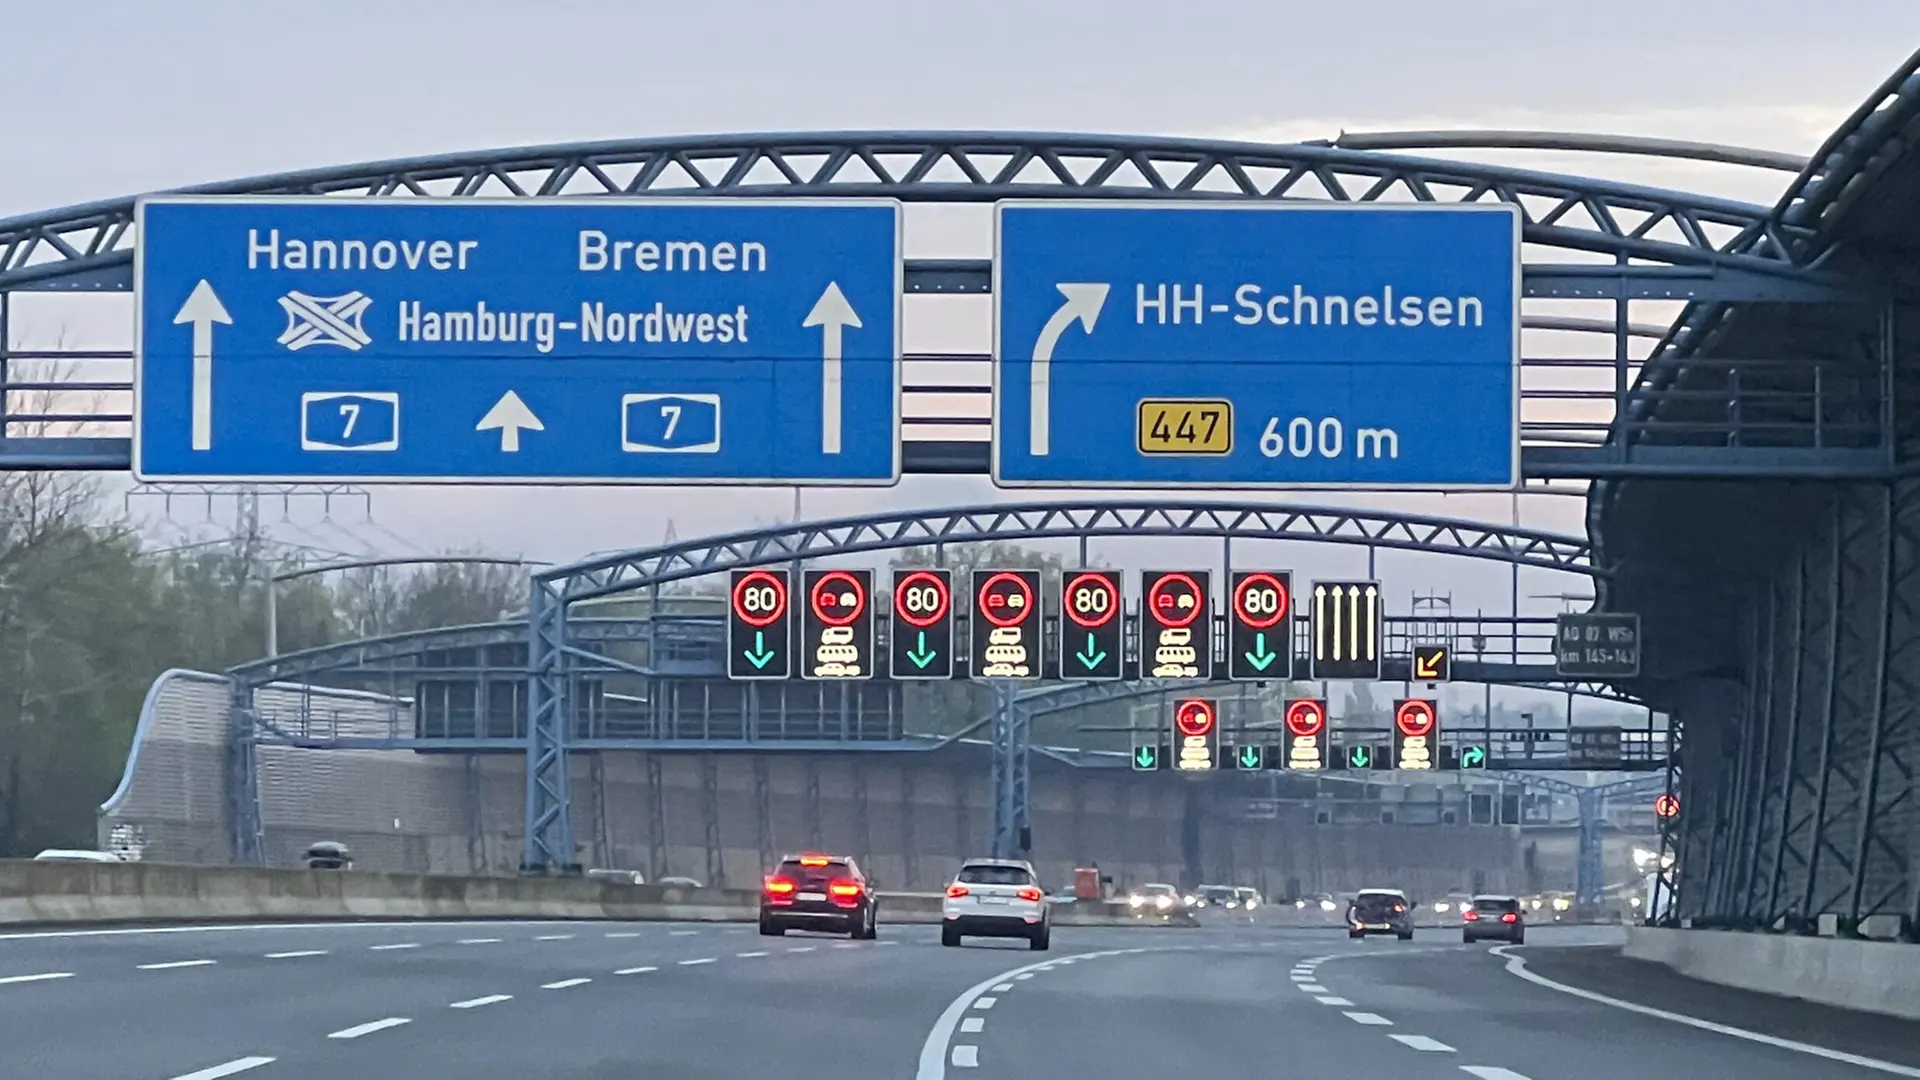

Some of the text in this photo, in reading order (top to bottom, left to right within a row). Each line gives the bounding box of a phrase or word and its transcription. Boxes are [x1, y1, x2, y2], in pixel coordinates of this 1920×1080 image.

[248, 229, 478, 270] Hannover
[579, 230, 766, 272] Bremen
[1136, 283, 1483, 327] HH-Schnelsen
[399, 301, 749, 353] Hamburg-Nordwest
[339, 404, 360, 438] 7
[661, 405, 683, 439] 7
[1151, 411, 1220, 444] 447
[1259, 417, 1398, 459] 600 m
[744, 587, 776, 611] 80
[907, 587, 939, 611] 80
[1075, 588, 1107, 613] 80
[1244, 588, 1277, 613] 80
[1560, 648, 1580, 663] km
